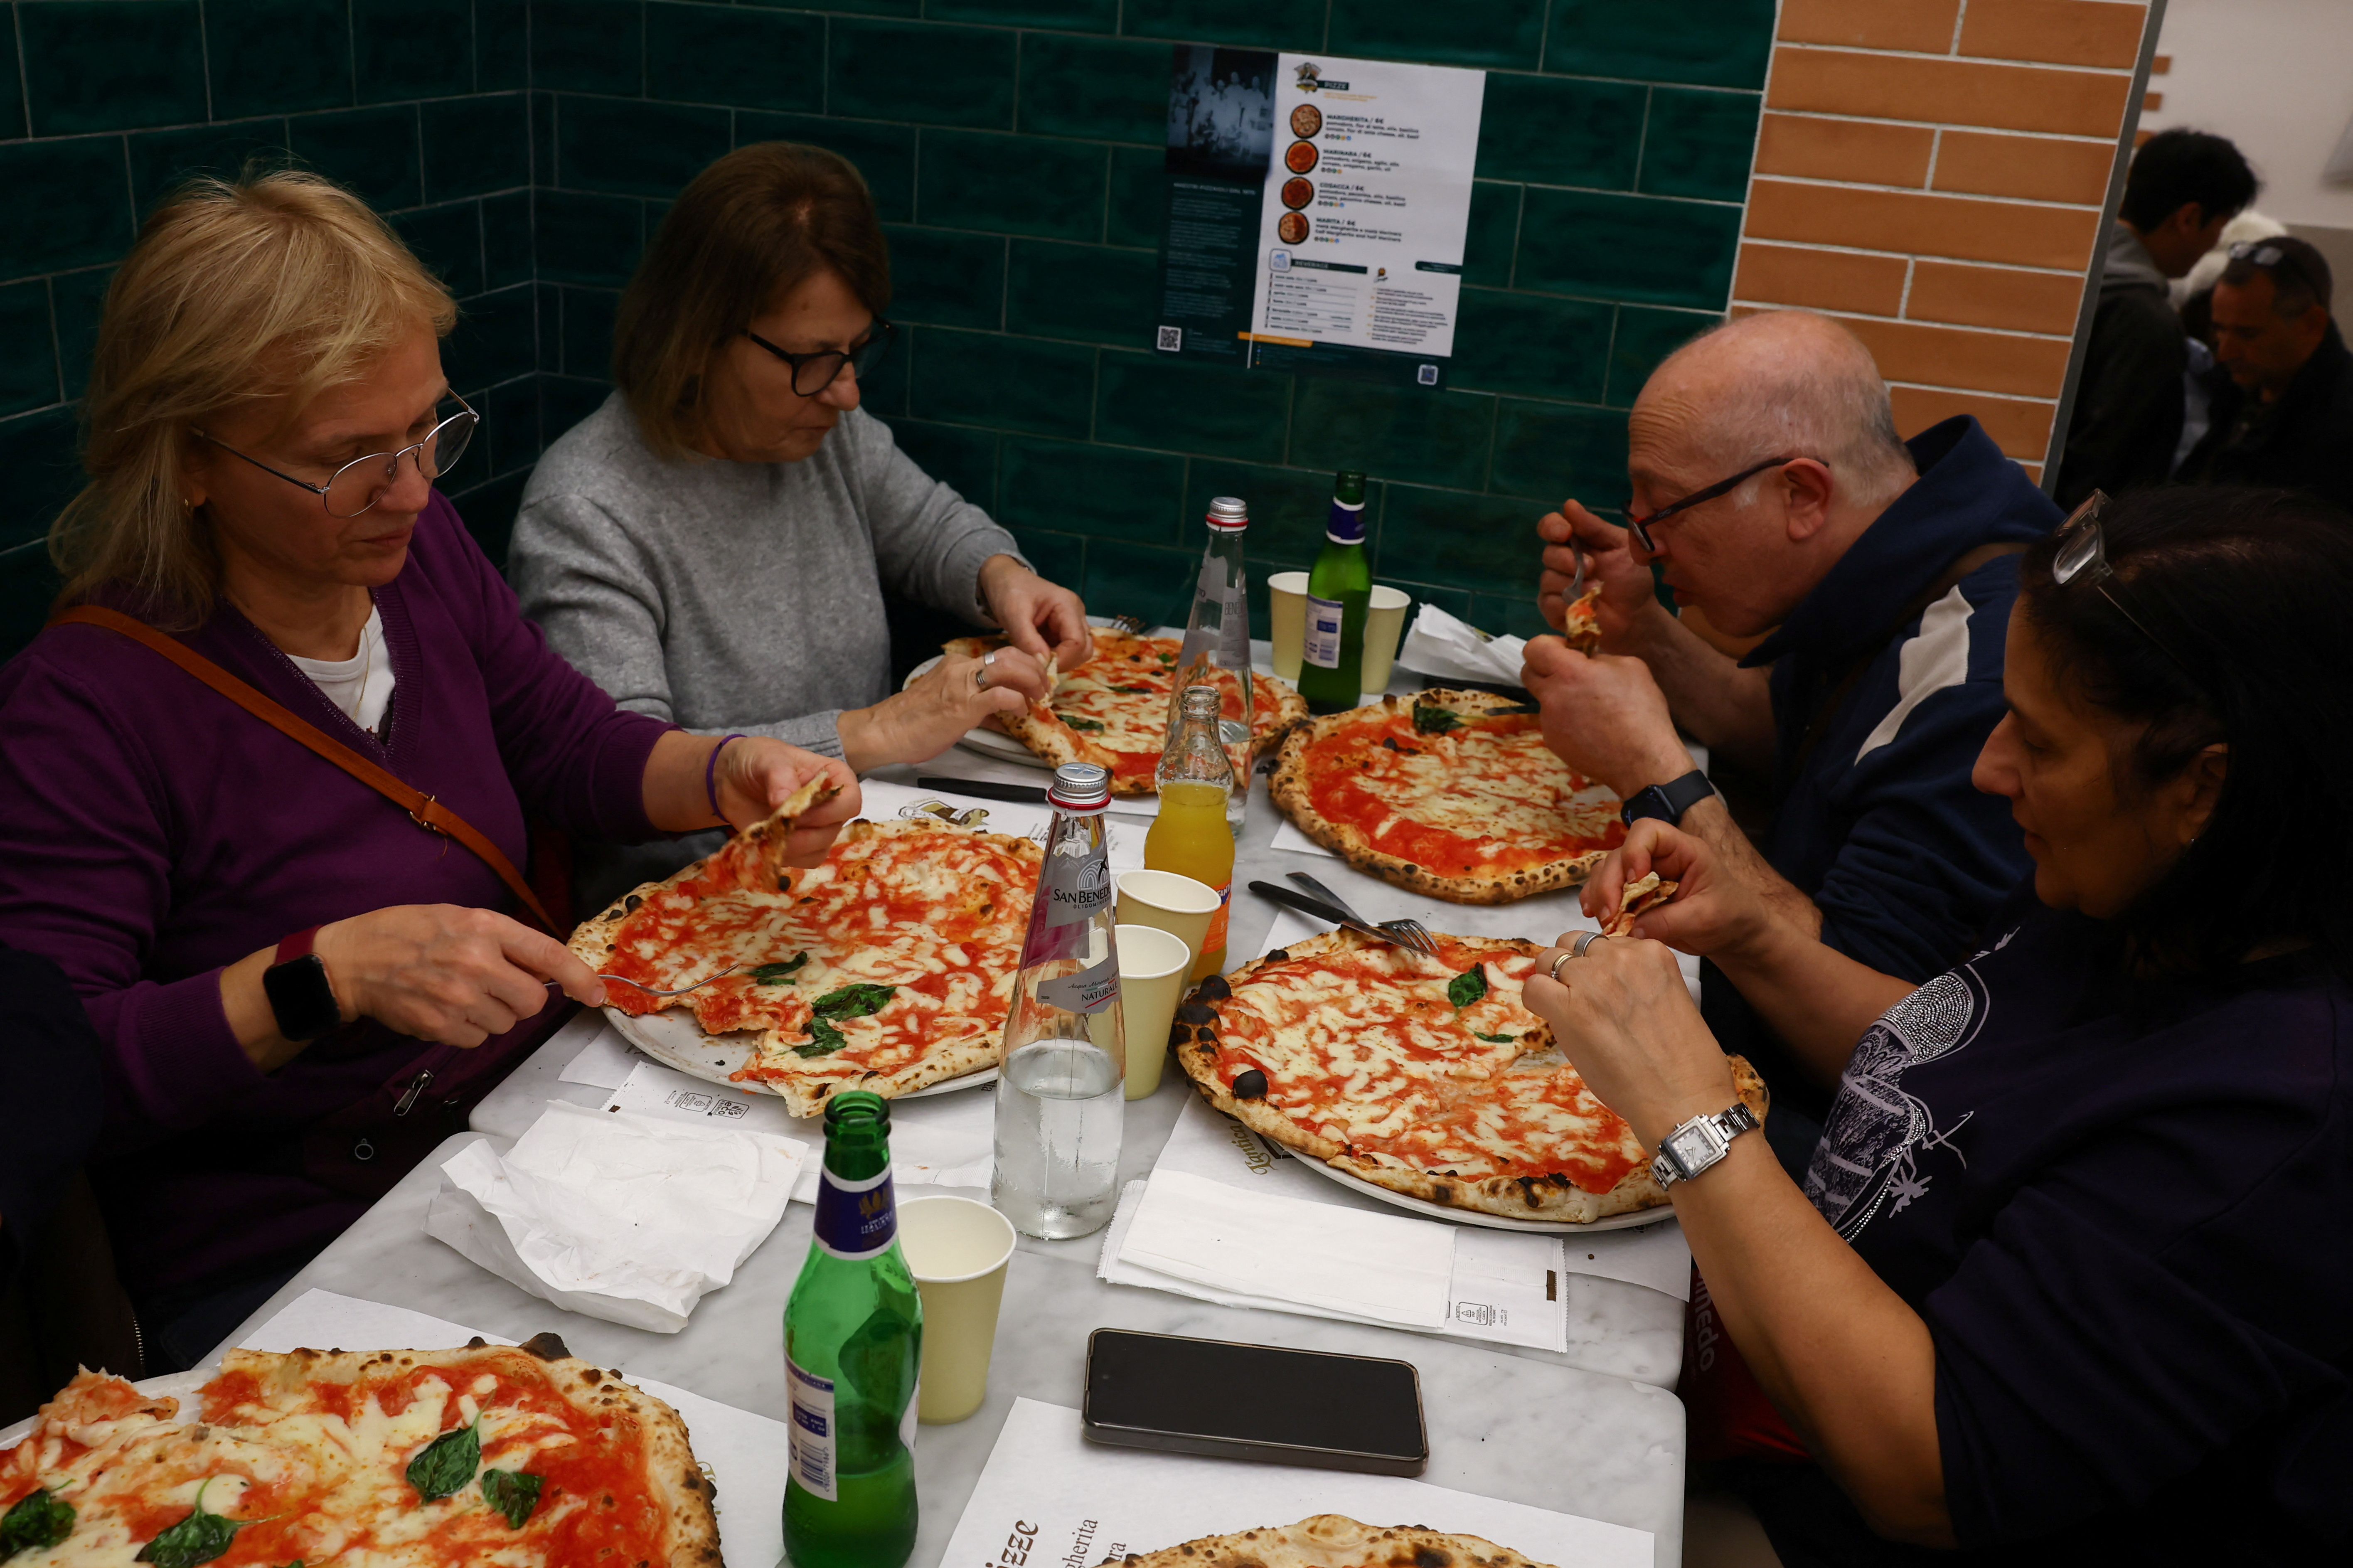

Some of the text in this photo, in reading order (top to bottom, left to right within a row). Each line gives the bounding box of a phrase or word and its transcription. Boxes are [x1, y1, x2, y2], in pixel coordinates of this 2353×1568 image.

[1053, 884, 1111, 903] SAN BENEDE
[1073, 896, 1112, 909] OLIGOMINERA
[1081, 981, 1117, 1002] NATURALE
[985, 1520, 1039, 1568] zze
[1062, 1519, 1098, 1568] gherita
